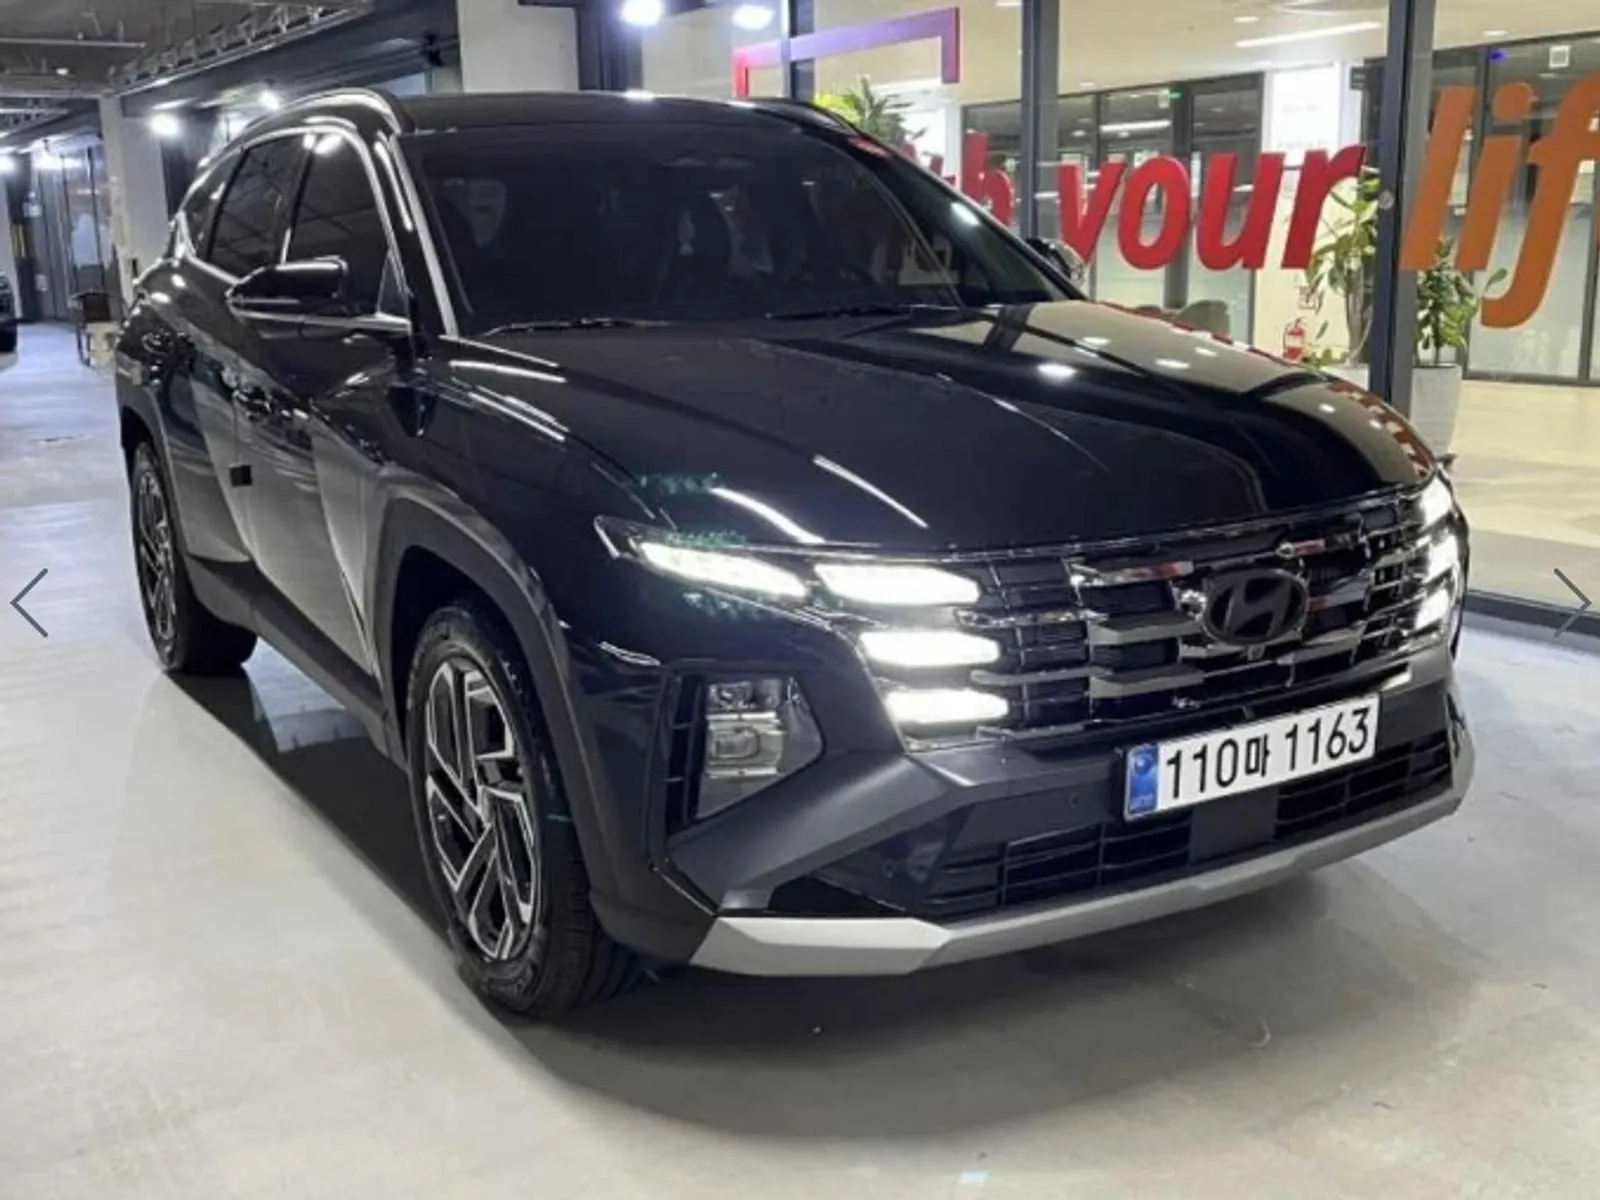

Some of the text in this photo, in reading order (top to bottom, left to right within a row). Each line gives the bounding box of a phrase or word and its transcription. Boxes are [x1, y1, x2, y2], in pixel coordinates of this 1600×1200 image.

[1058, 145, 1366, 271] your
[1399, 76, 1600, 329] lif
[1167, 707, 1370, 799] 110마 1163
